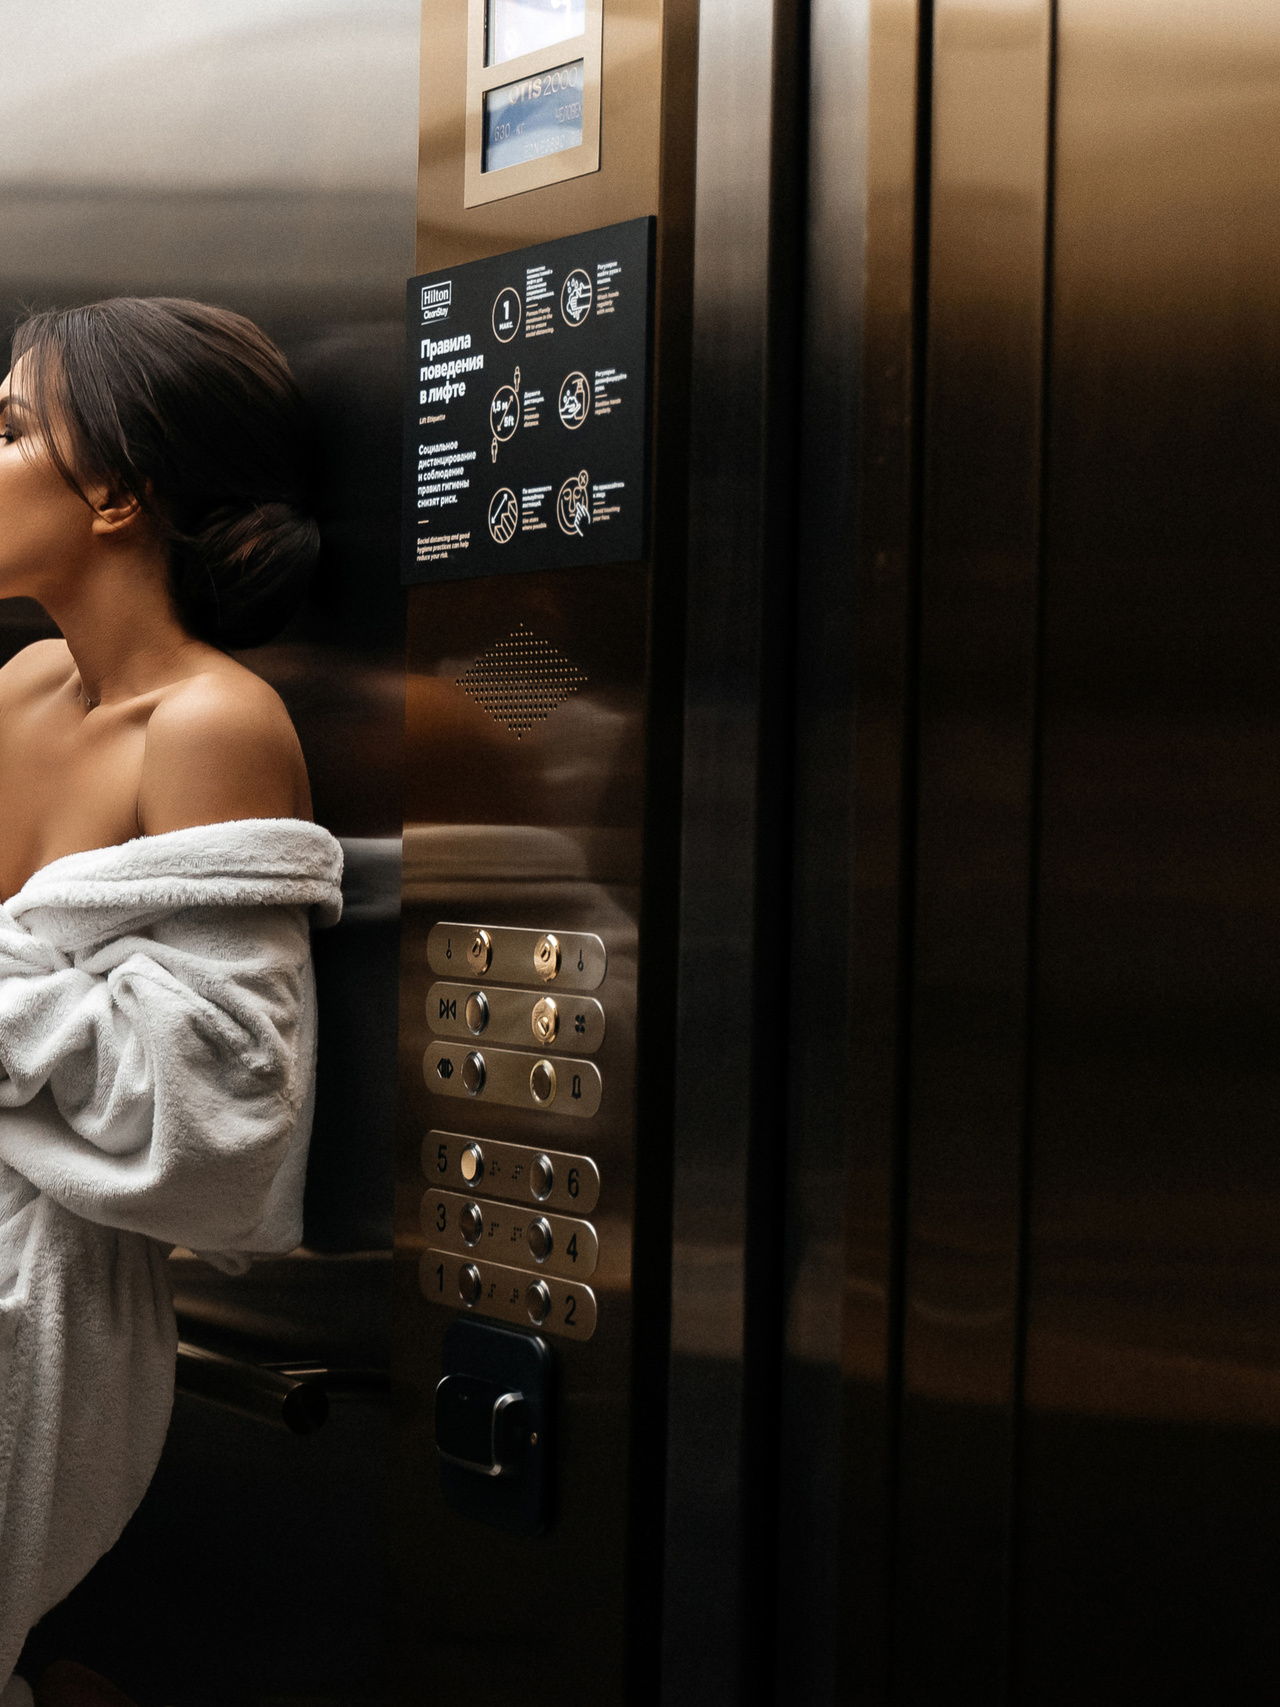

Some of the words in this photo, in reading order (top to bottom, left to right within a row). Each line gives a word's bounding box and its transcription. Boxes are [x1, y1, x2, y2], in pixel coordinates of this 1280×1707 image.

[510, 78, 542, 104] OTIS
[543, 67, 578, 97] 2000
[494, 122, 511, 141] 630
[423, 289, 449, 305] Hilton
[503, 300, 510, 320] 1
[421, 334, 471, 361] Правила
[420, 354, 484, 381] поведения
[420, 390, 427, 404] в
[427, 380, 466, 404] лифте
[492, 400, 501, 414] 1,5
[503, 415, 515, 427] 5ft
[418, 441, 458, 456] Социальное
[417, 451, 477, 471] дистанцирование
[417, 473, 423, 482] и
[423, 467, 464, 481] соблюдение
[417, 484, 441, 497] правил
[441, 479, 470, 492] гигиены
[417, 497, 440, 509] снизят
[440, 494, 458, 507] риск.
[437, 1145, 448, 1173] 5
[567, 1168, 580, 1198] 6
[436, 1203, 447, 1233] 3
[566, 1233, 579, 1263] 4
[436, 1263, 444, 1292] 1
[564, 1295, 576, 1326] 2
